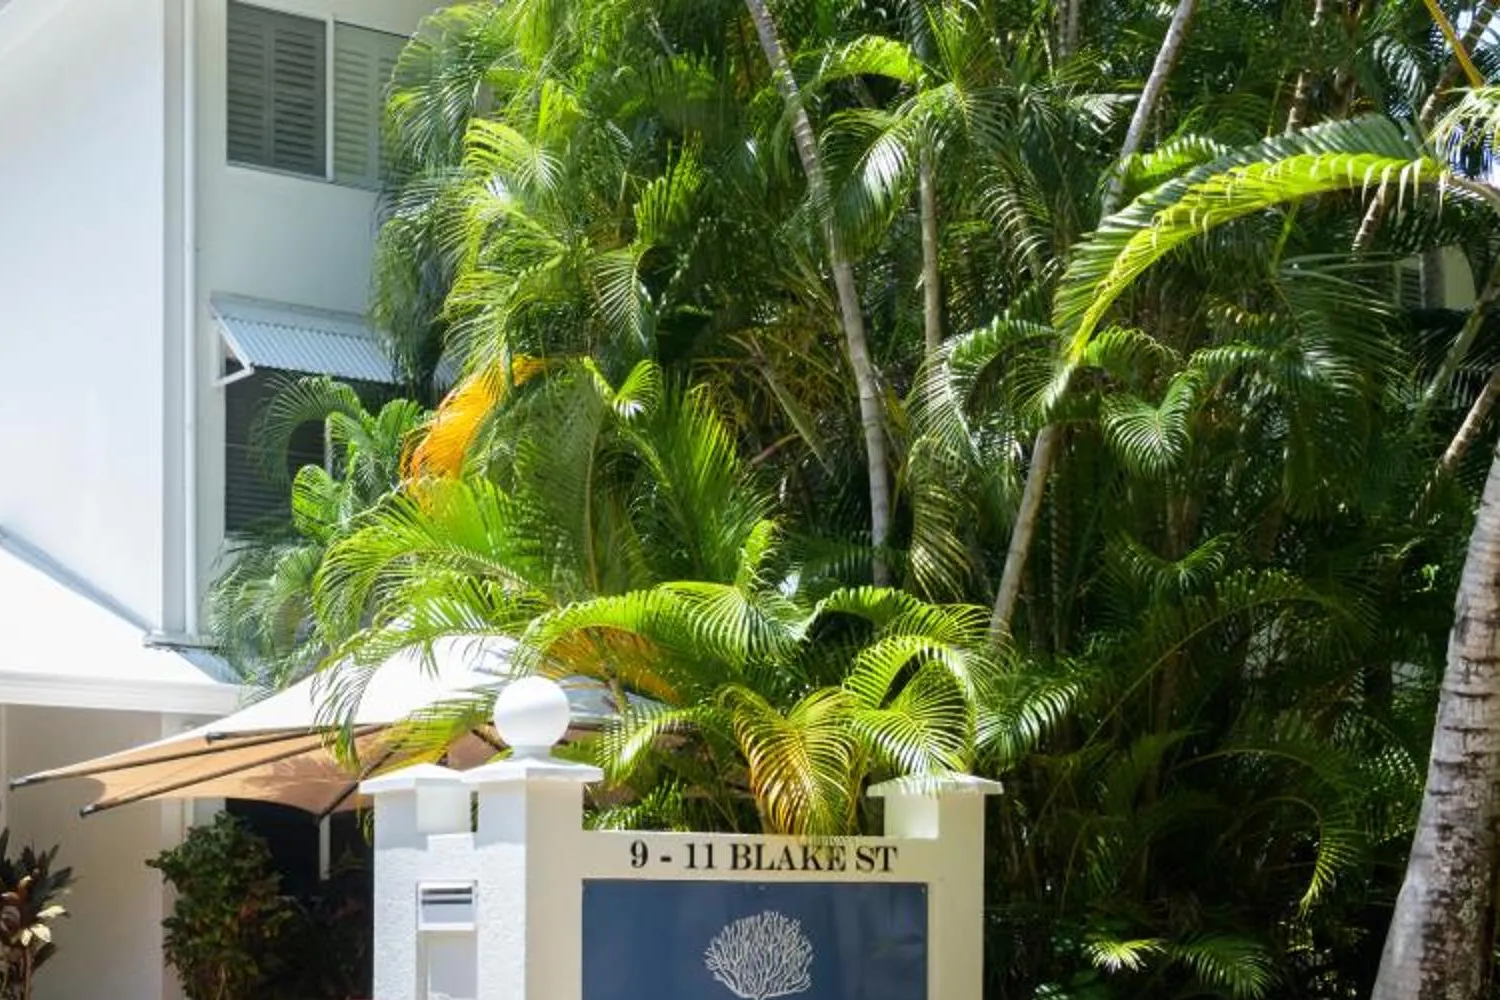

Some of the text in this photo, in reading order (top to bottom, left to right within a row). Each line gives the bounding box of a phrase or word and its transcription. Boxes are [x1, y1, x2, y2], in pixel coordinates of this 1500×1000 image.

[630, 839, 649, 869] 9
[683, 842, 716, 869] 11
[729, 842, 846, 871] BLAKE
[855, 845, 898, 872] ST
